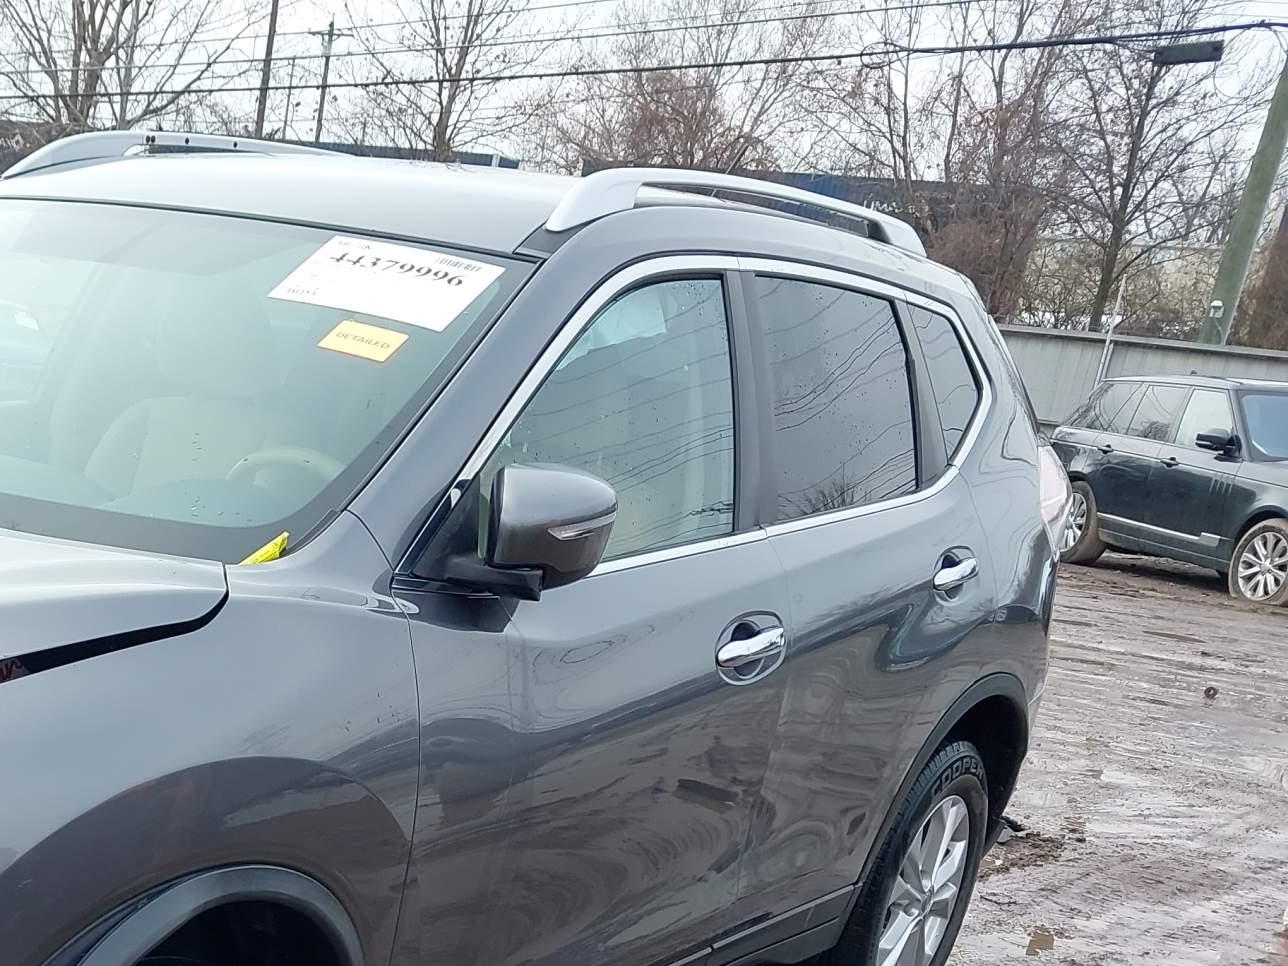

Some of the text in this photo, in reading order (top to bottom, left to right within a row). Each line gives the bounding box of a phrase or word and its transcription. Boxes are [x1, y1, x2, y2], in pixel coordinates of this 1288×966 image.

[329, 251, 464, 287] 44379996
[335, 330, 391, 350] DETAILED
[931, 757, 984, 796] COOPER
